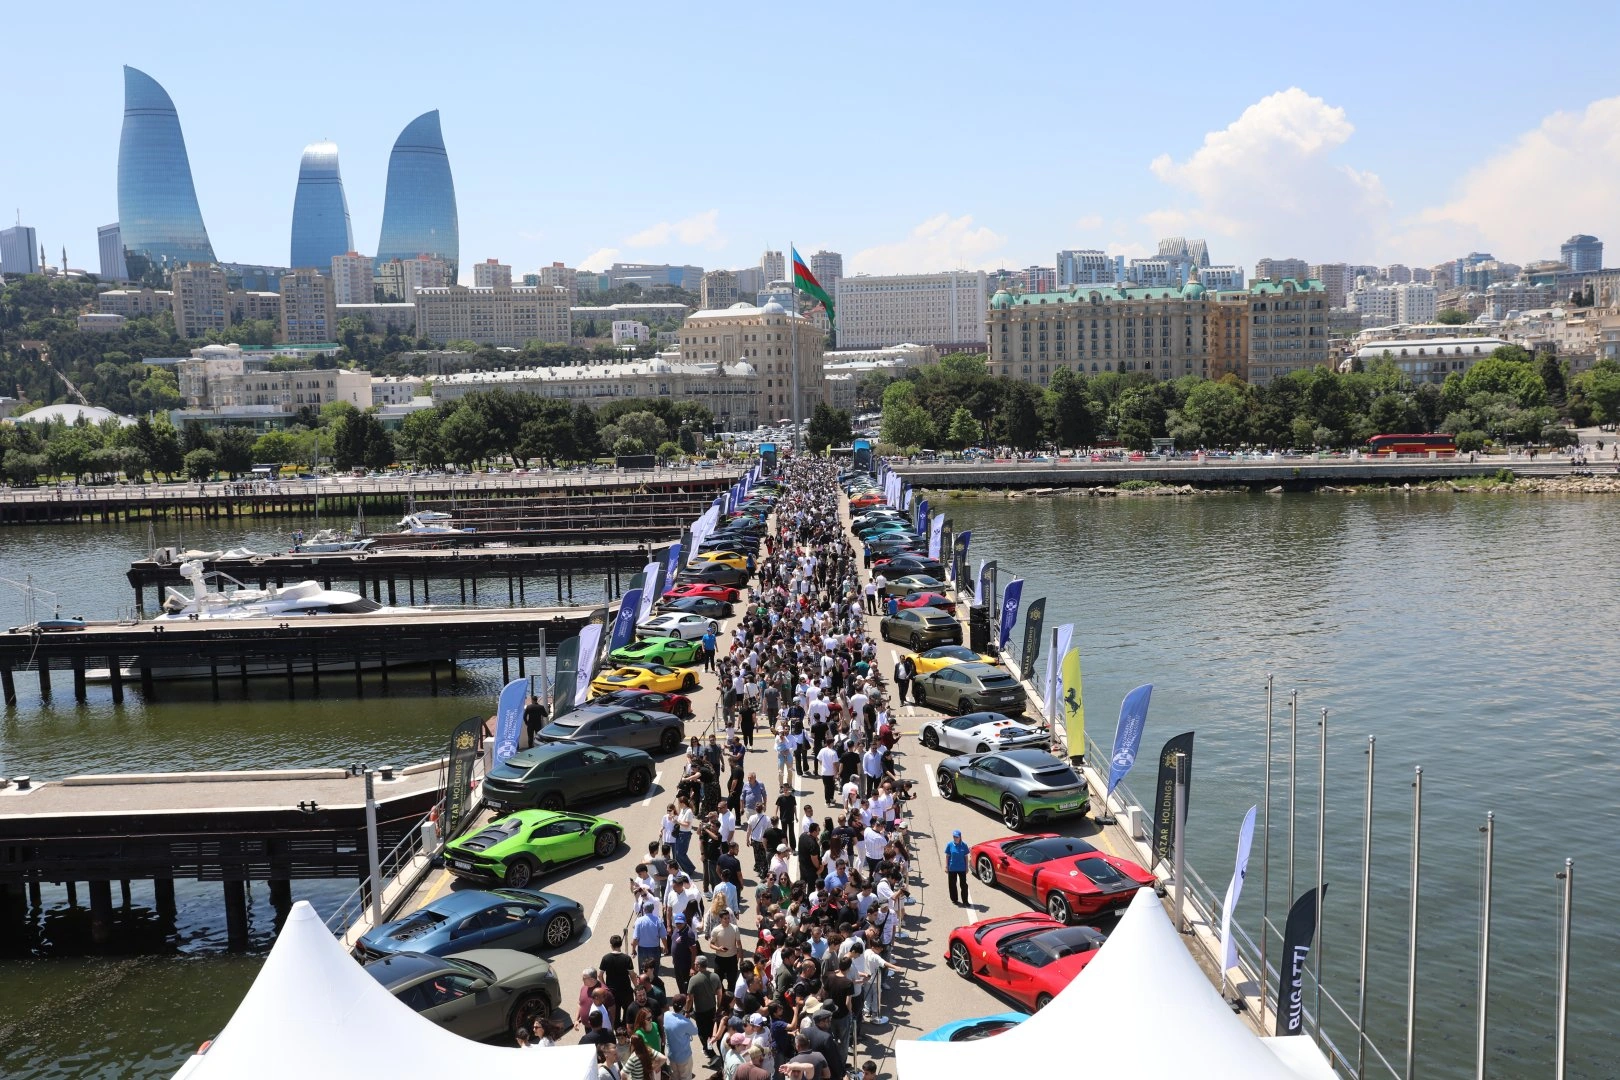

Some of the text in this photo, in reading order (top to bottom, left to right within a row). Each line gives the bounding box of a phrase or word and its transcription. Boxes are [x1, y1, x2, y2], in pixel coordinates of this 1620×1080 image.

[452, 759, 463, 800] HOLDINGS
[1161, 779, 1174, 824] HOLDINGS
[1158, 828, 1169, 860] NAZAR
[1288, 945, 1310, 1030] BUGATTI
